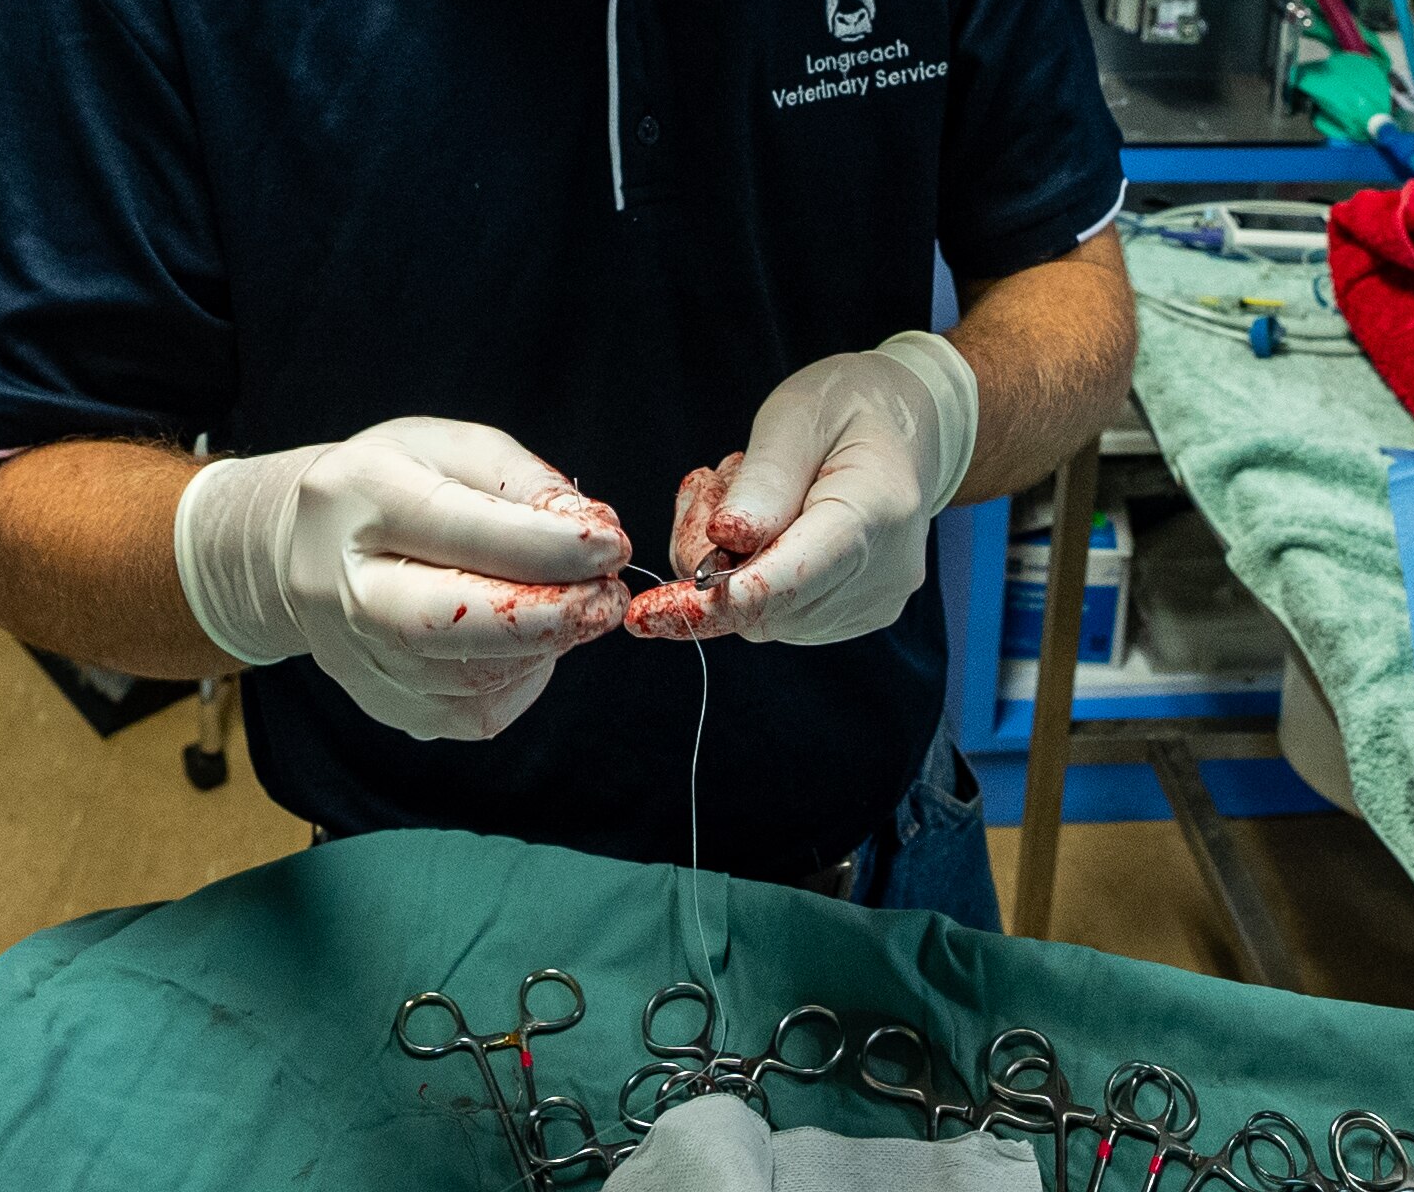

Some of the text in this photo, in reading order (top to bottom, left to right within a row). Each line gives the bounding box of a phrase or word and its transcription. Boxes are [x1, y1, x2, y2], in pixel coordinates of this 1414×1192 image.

[806, 39, 909, 74] Longreach
[772, 61, 949, 108] Veterinary Service
